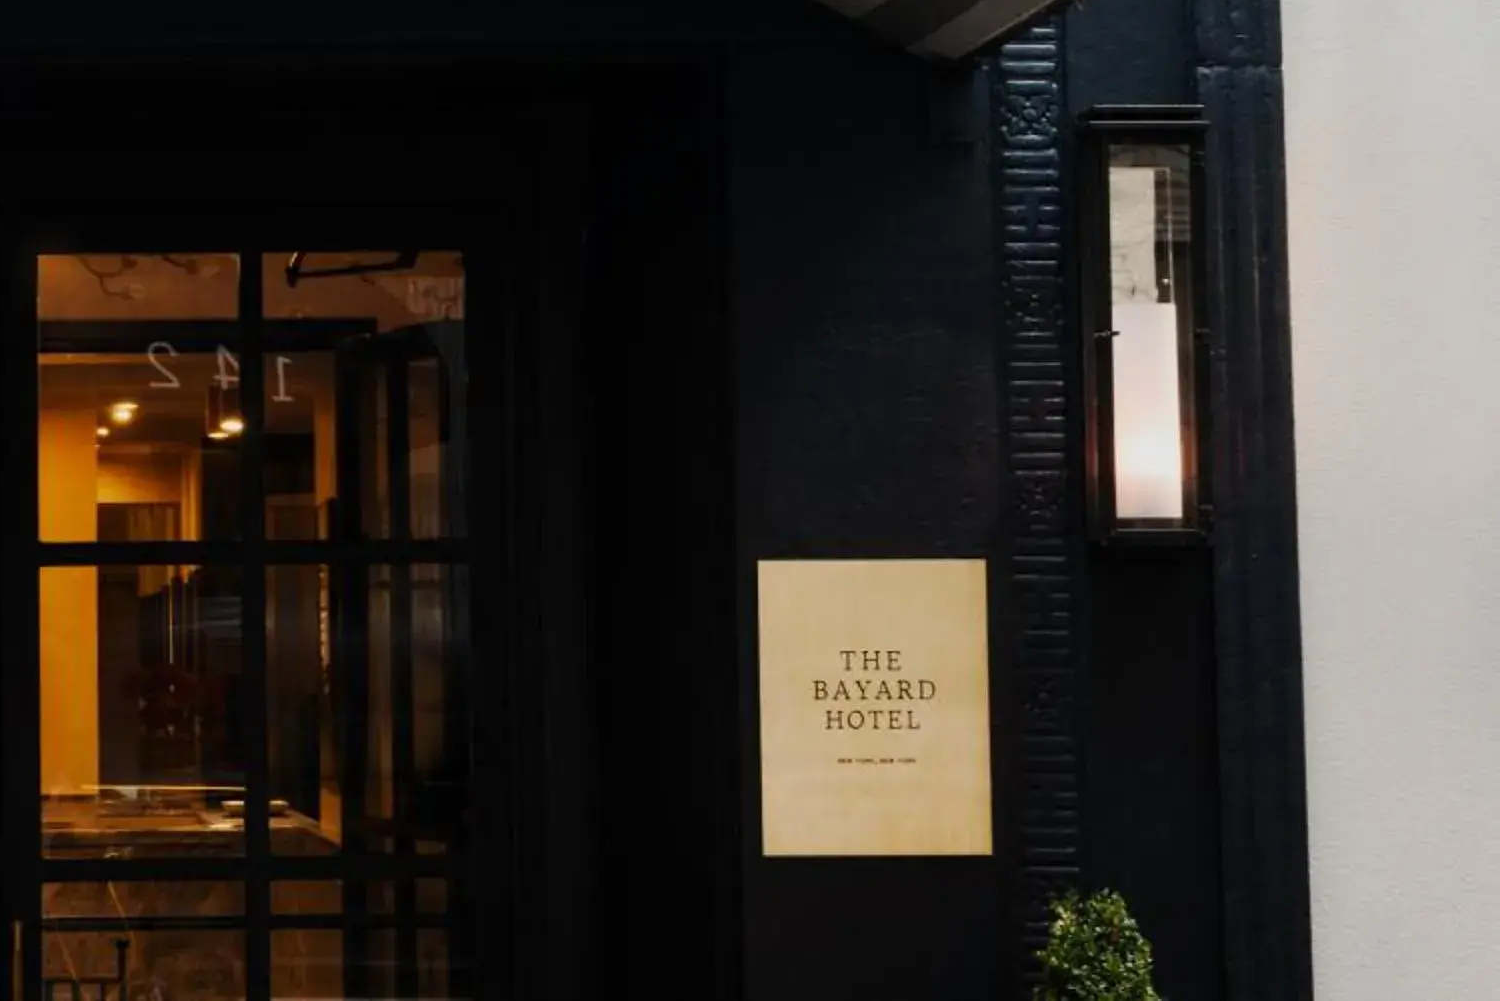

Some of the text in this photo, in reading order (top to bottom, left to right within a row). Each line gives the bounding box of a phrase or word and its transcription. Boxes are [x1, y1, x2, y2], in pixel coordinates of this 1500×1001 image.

[840, 650, 902, 671] THE
[812, 680, 936, 700] BAYARD
[825, 710, 921, 730] HOTEL
